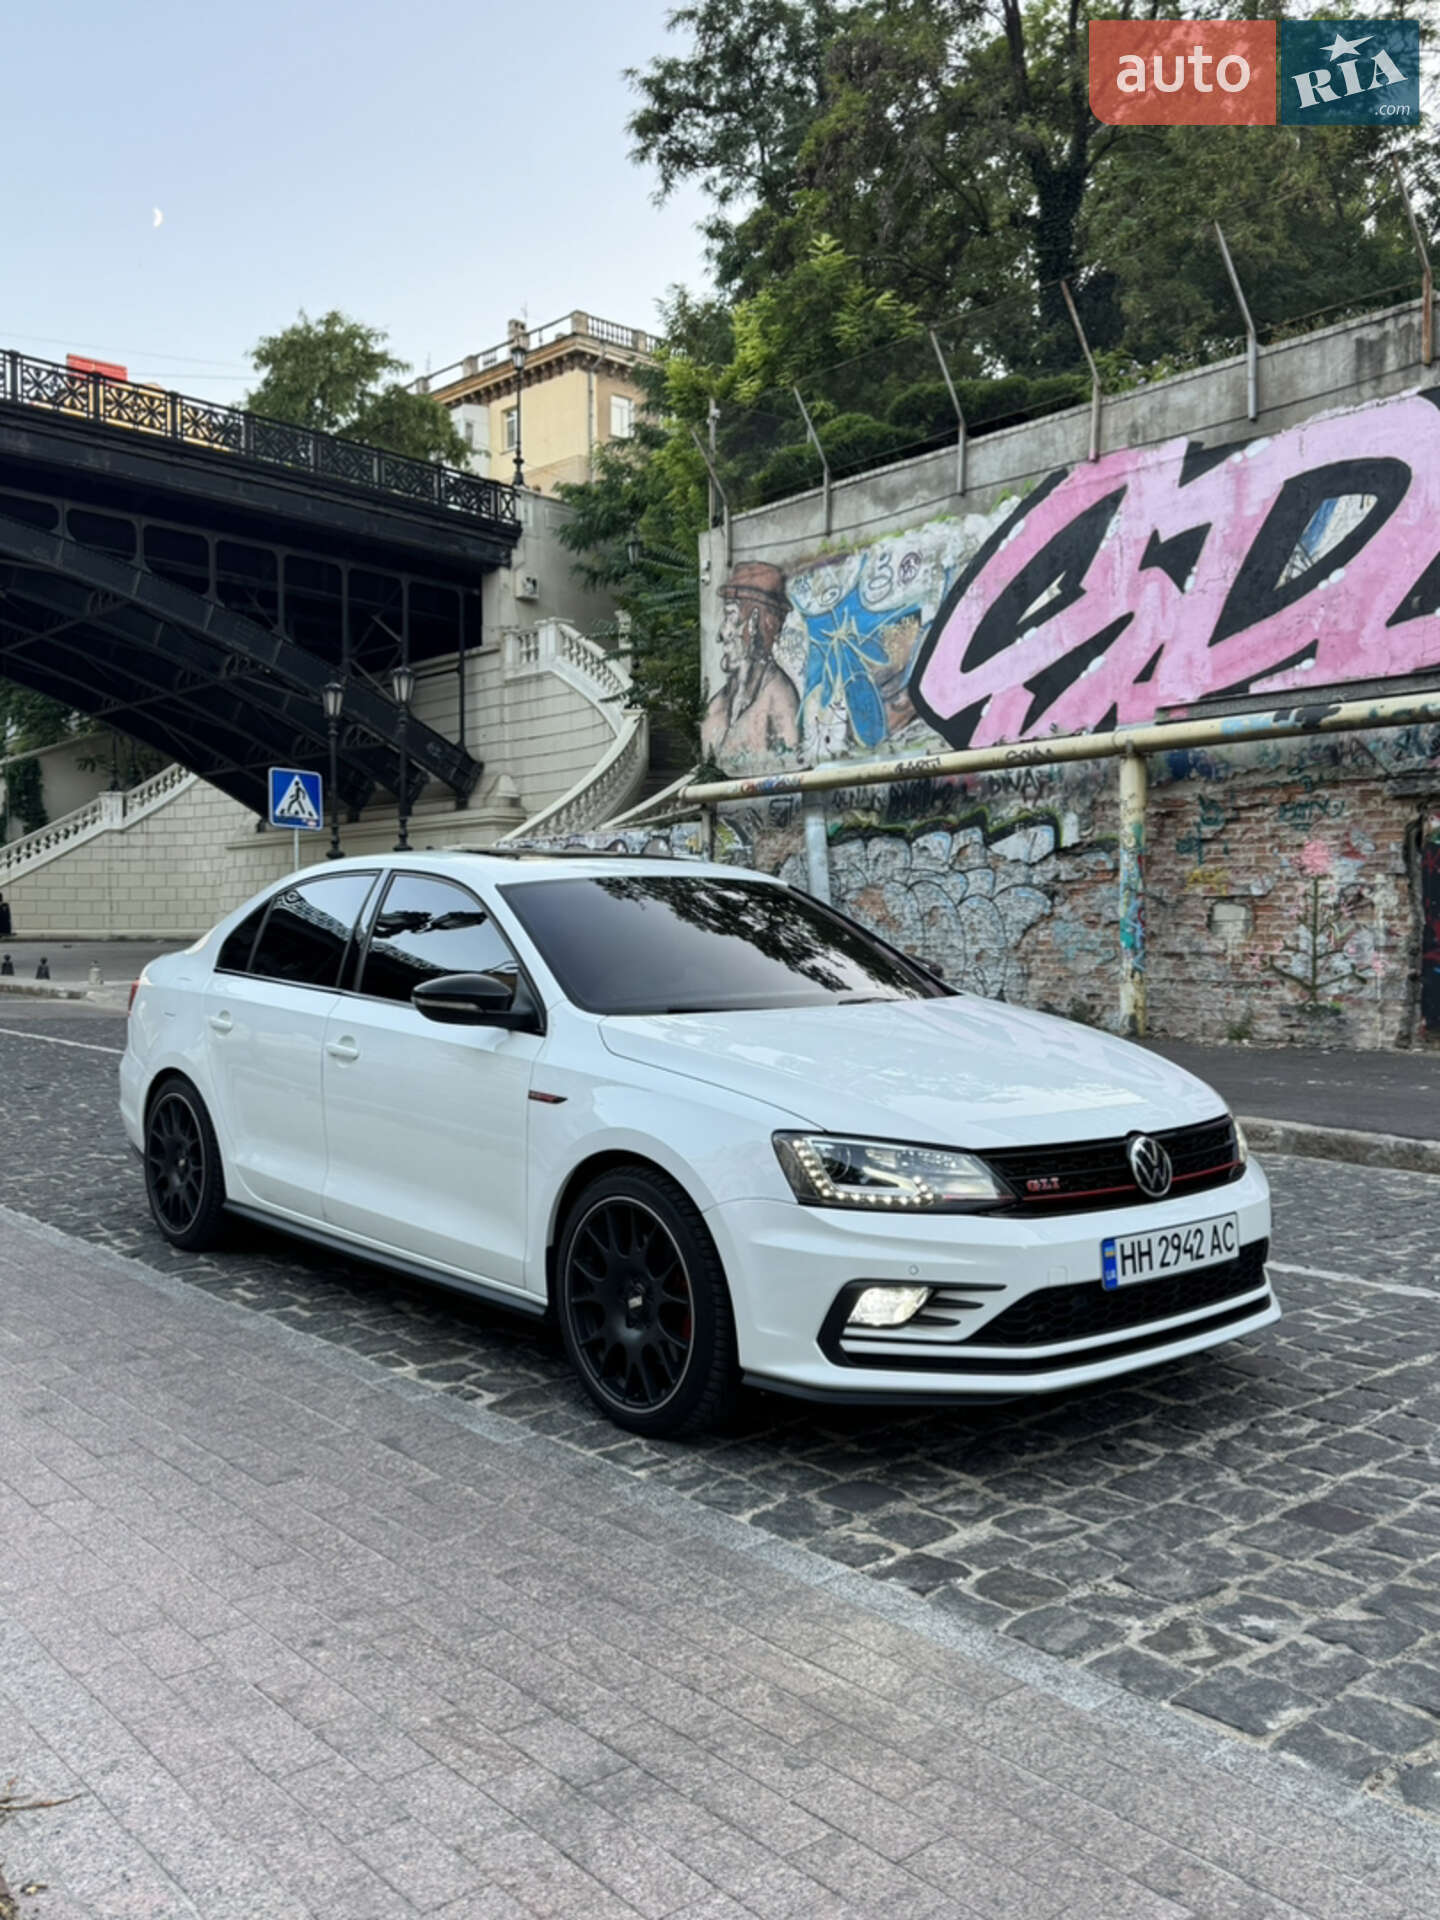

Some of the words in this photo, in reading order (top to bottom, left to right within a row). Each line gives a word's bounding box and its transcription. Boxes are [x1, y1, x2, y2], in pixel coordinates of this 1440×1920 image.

[1120, 1238, 1153, 1276] HH
[1158, 1229, 1203, 1268] 2942
[1210, 1222, 1235, 1255] AC
